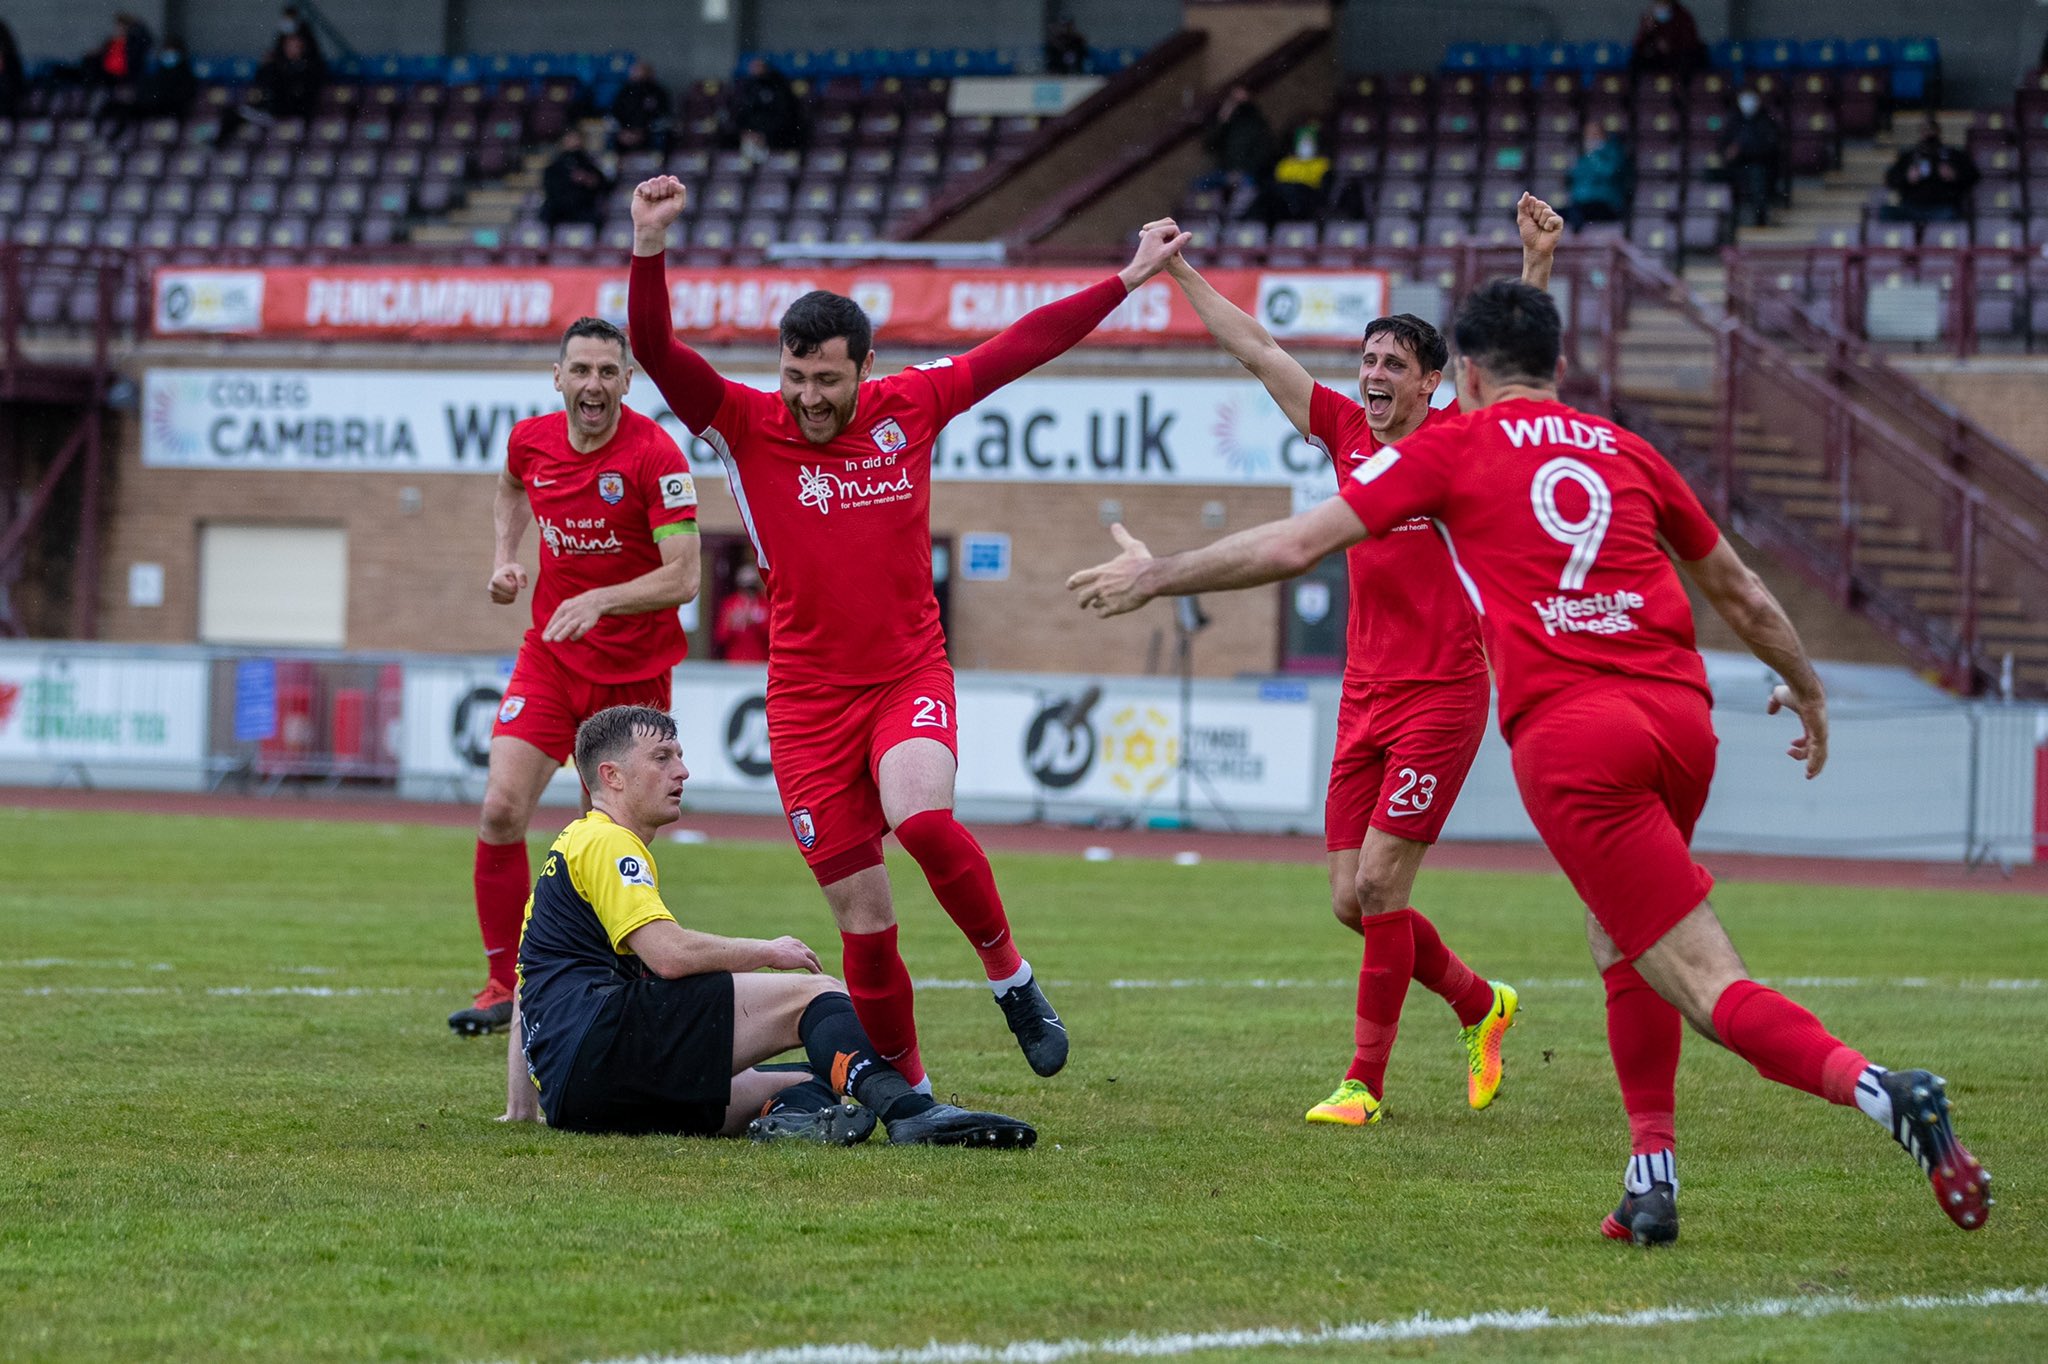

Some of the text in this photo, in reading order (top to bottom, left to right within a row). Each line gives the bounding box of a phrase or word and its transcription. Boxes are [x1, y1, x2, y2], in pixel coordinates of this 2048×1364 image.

[209, 416, 418, 459] CAMBRIA
[1499, 415, 1618, 455] WILDE
[845, 453, 898, 472] In aid of
[839, 467, 914, 500] mind
[563, 529, 623, 549] mind
[1530, 456, 1612, 590] 9
[911, 696, 948, 728] 21
[1388, 767, 1437, 810] 23
